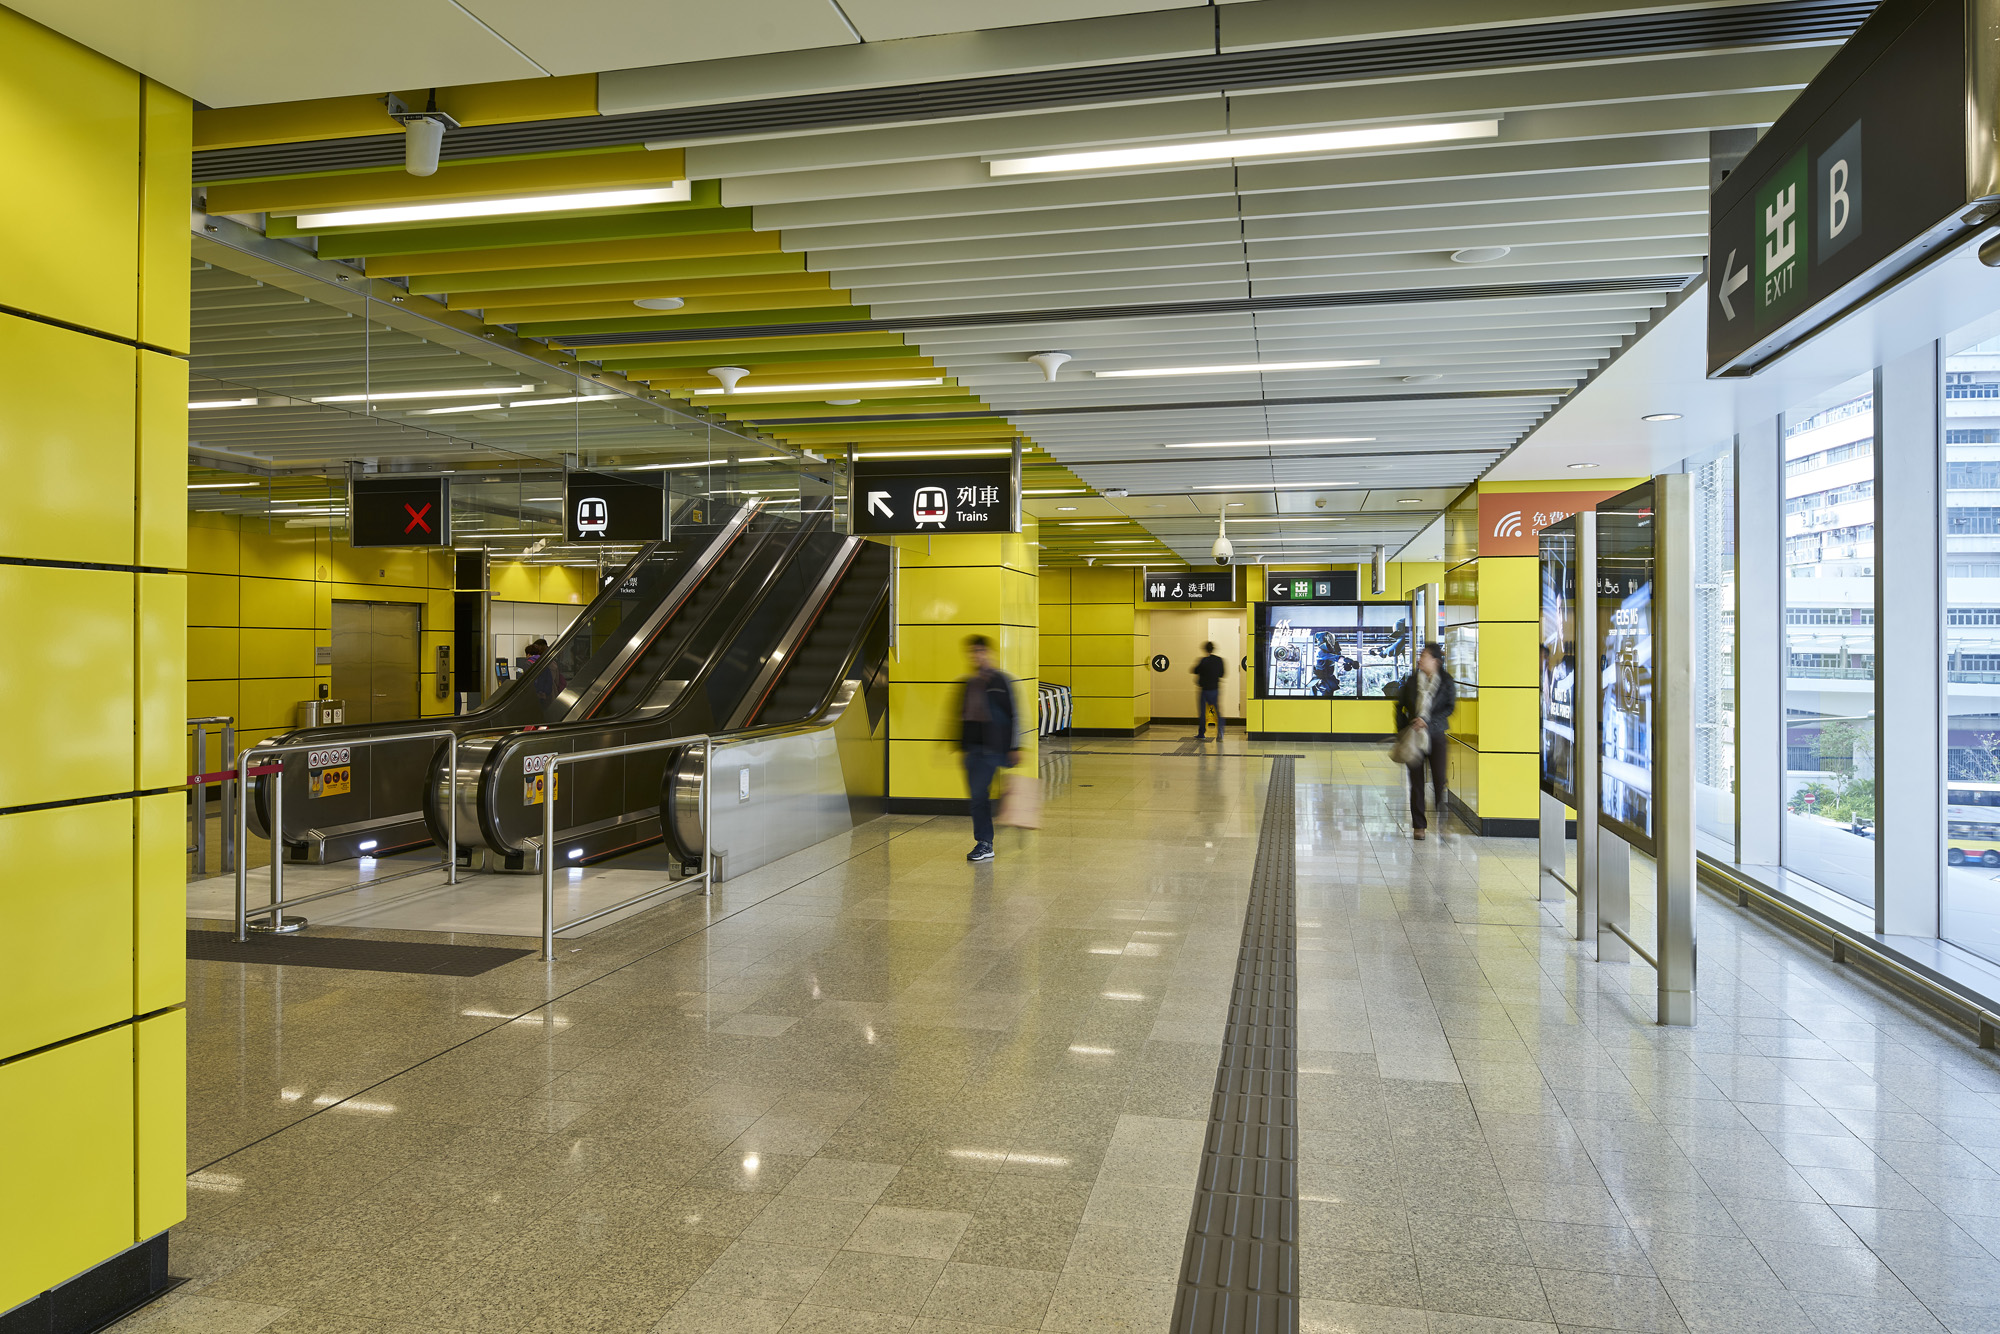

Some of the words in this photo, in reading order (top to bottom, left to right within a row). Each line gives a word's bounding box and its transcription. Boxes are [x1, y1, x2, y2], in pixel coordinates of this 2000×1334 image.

[1829, 159, 1850, 240] B
[1765, 182, 1796, 277] 出
[1765, 261, 1796, 307] EXIT
[956, 485, 1000, 508] 列車
[956, 511, 988, 522] Trains
[1187, 582, 1216, 592] 洗手間
[1295, 581, 1308, 593] 出
[1319, 584, 1327, 595] B
[1275, 619, 1291, 629] 4K
[1616, 609, 1630, 626] EOS
